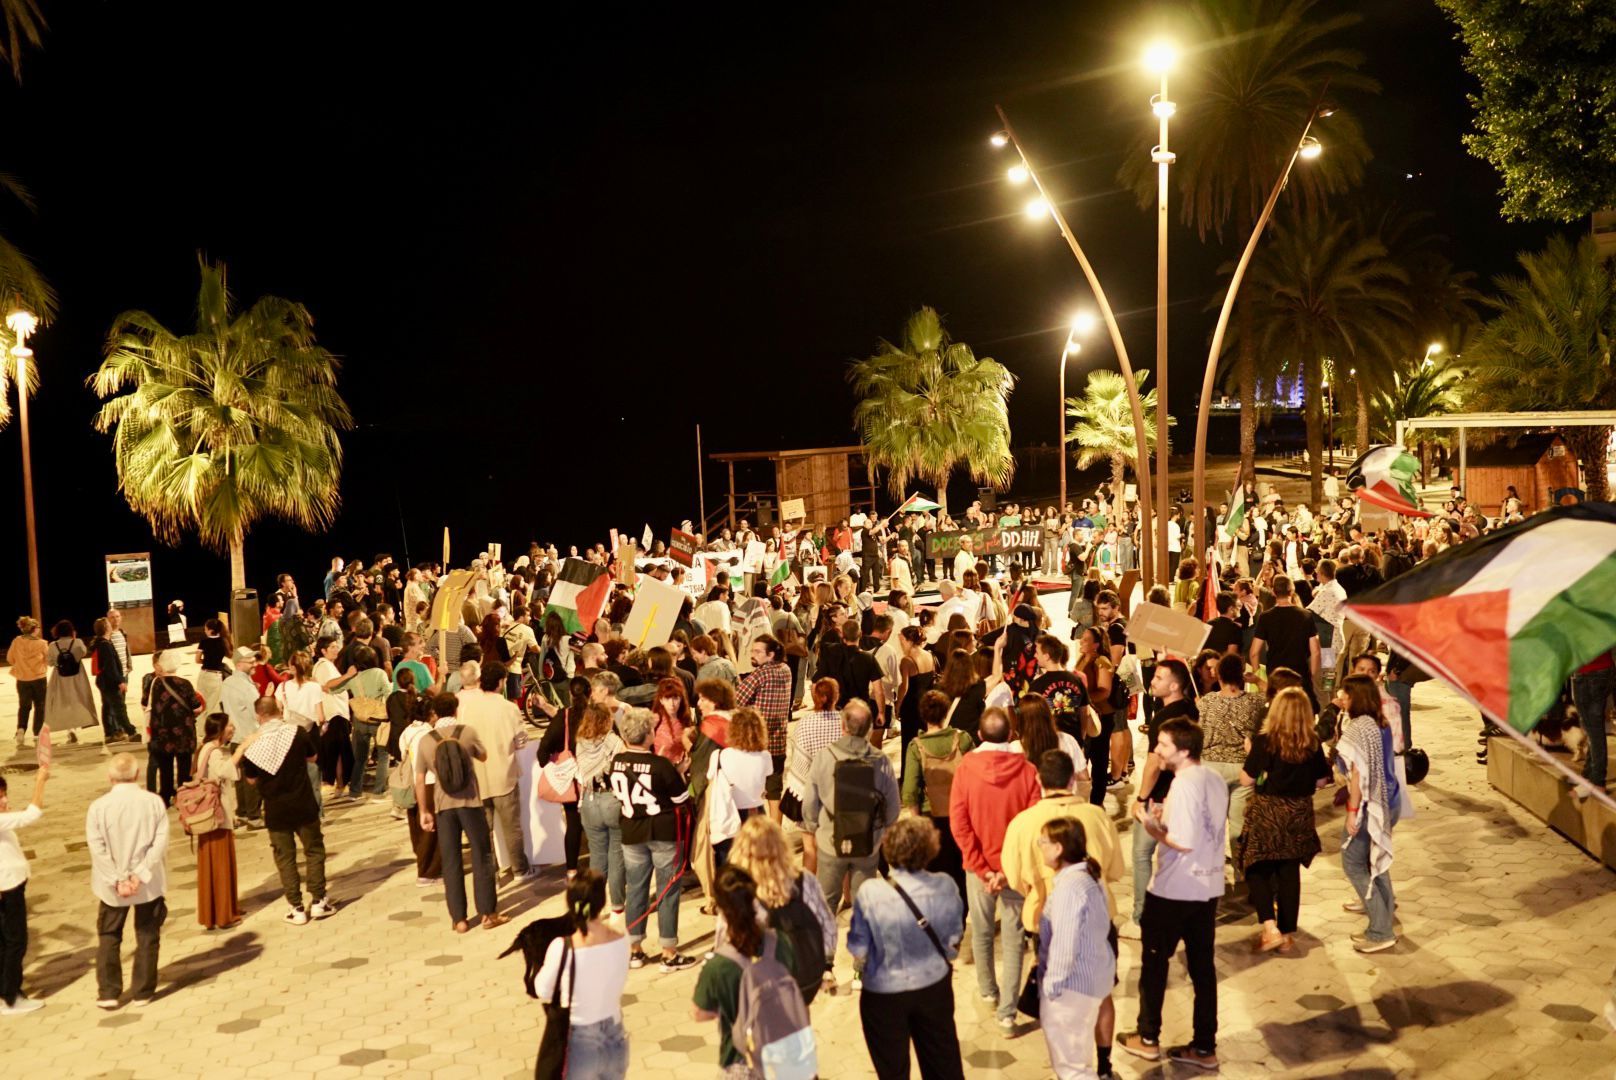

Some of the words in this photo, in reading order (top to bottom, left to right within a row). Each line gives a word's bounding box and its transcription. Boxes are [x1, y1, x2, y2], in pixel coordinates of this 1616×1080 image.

[1001, 530, 1041, 548] DD.HH.
[632, 763, 651, 774] SIDE
[610, 771, 661, 819] 94
